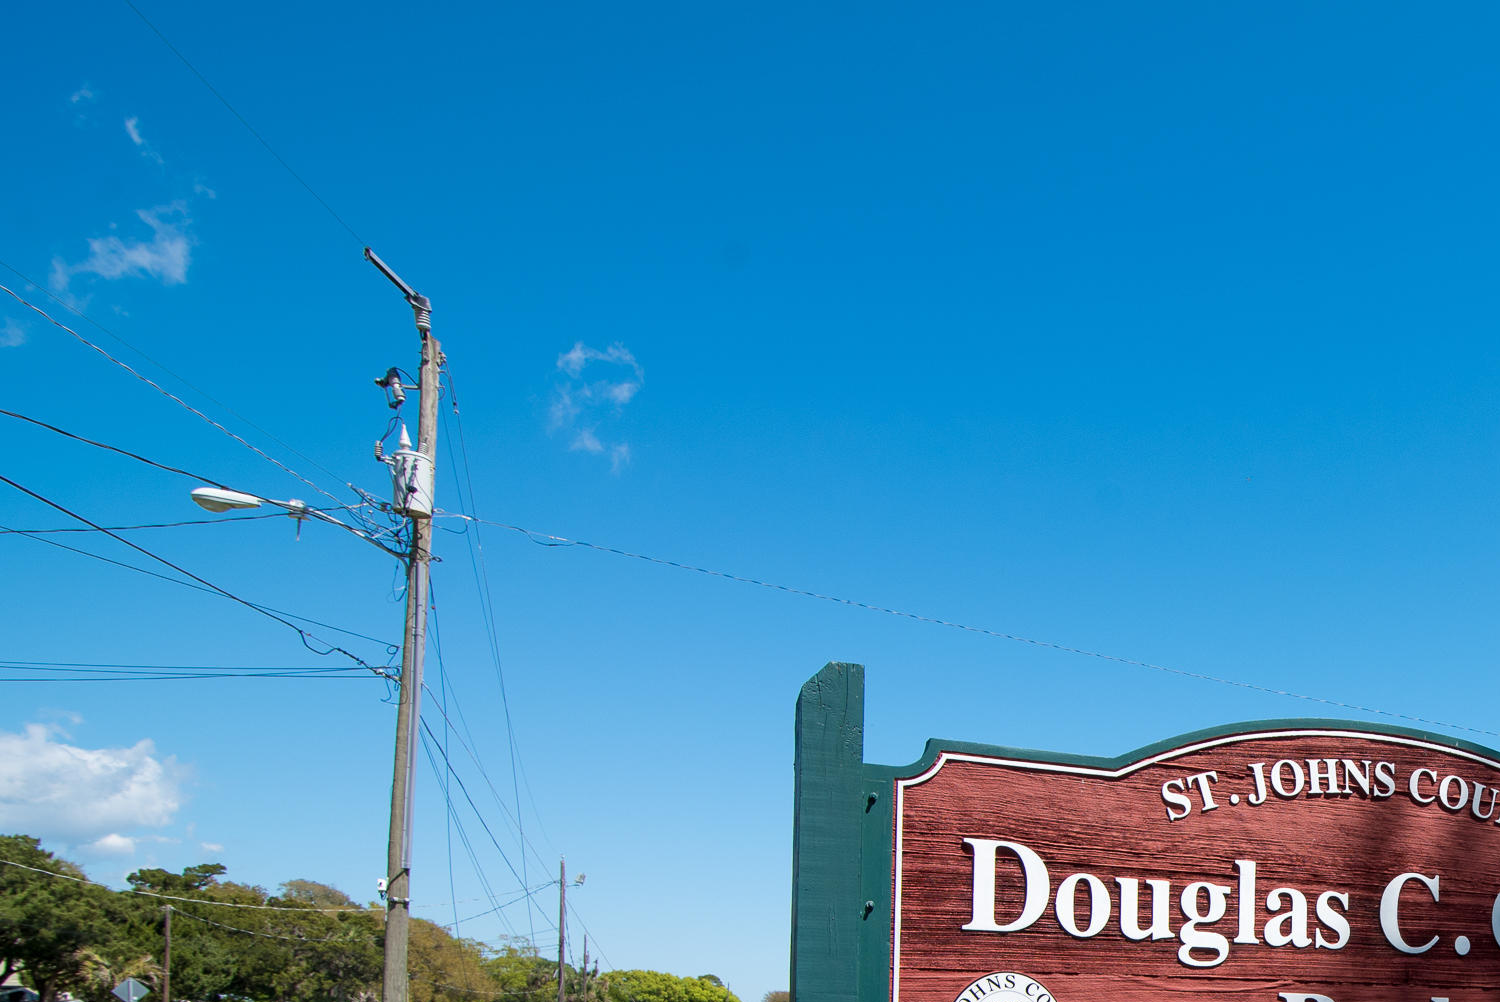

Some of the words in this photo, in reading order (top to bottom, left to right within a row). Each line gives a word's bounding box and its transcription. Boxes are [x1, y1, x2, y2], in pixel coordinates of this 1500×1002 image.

[1161, 771, 1239, 821] ST.
[1248, 759, 1396, 806] JOHNS
[961, 838, 1351, 967] Douglas
[1380, 873, 1471, 956] C.
